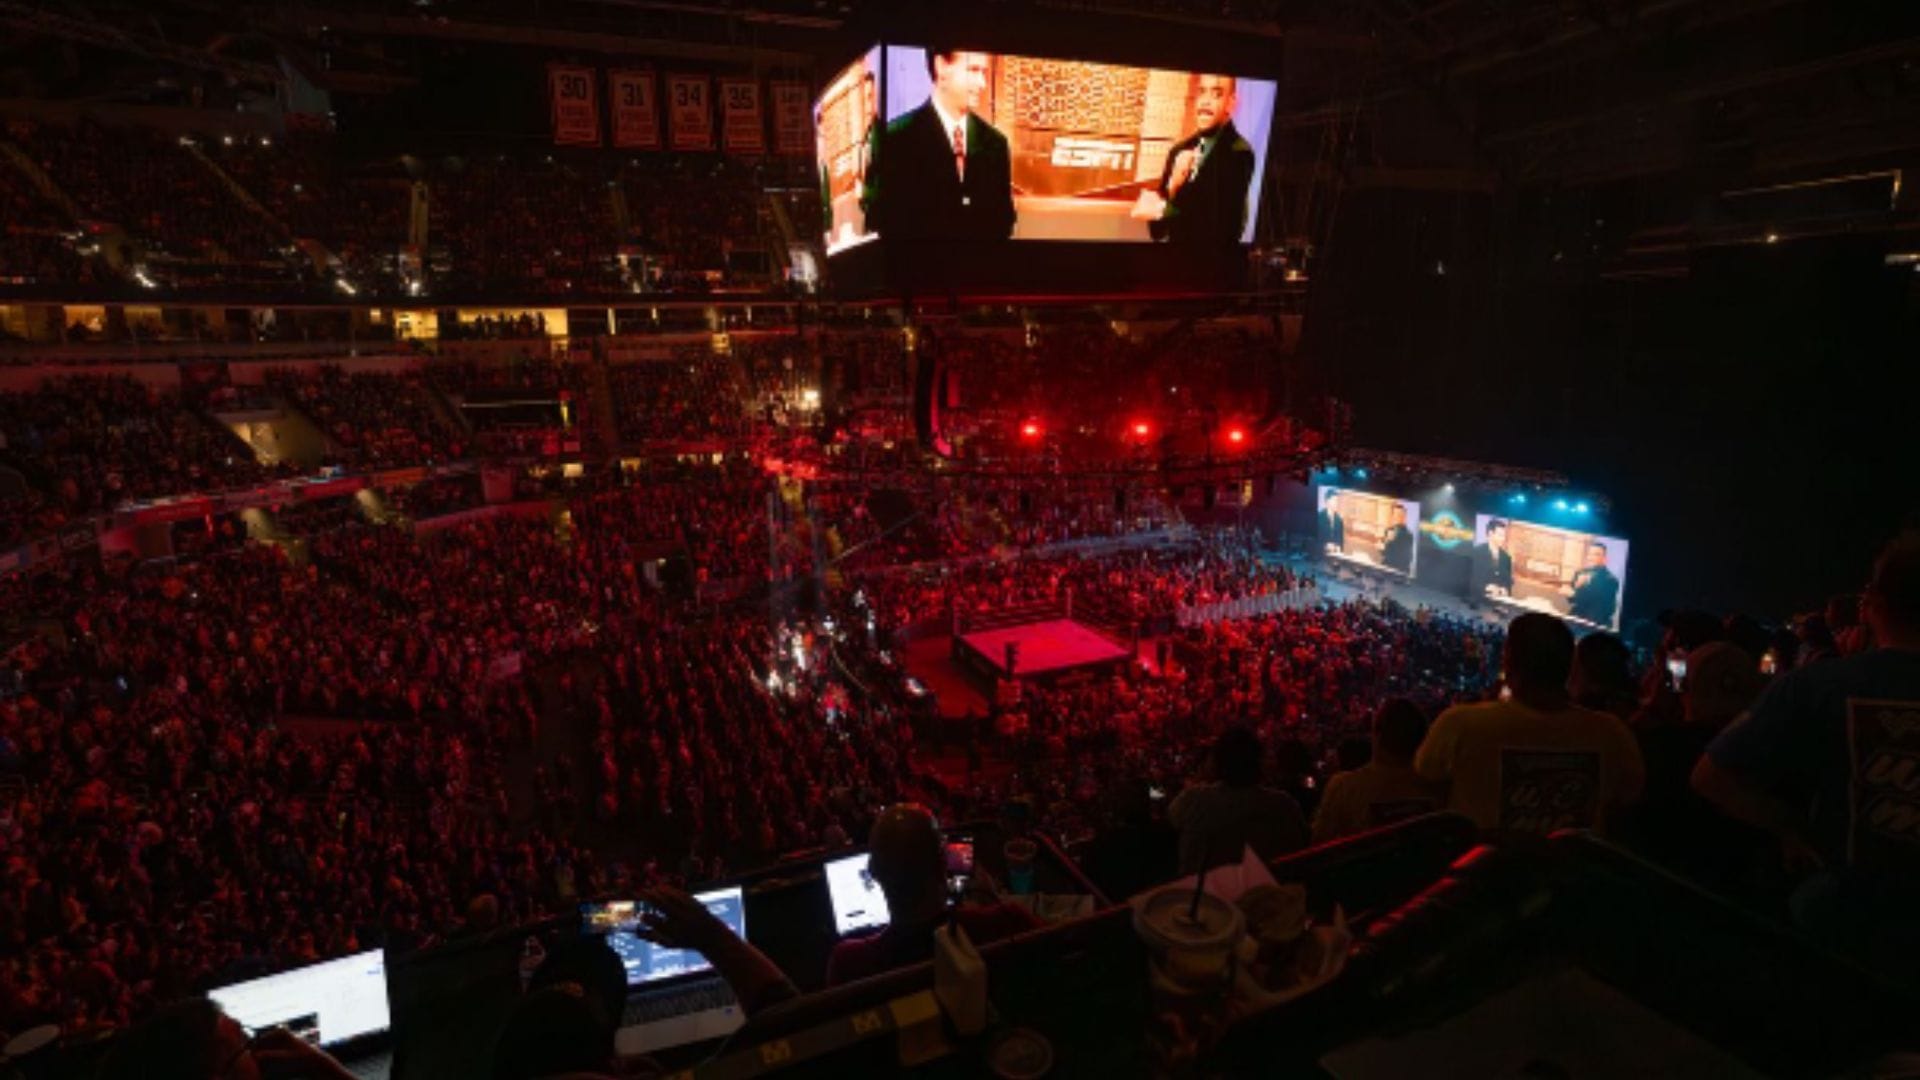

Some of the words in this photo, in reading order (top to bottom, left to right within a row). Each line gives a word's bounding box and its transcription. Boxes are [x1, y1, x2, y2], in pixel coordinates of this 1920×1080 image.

[560, 74, 586, 100] 30
[621, 82, 645, 107] 31
[675, 83, 701, 106] 34
[728, 86, 754, 110] 35
[1051, 137, 1134, 171] ESPN
